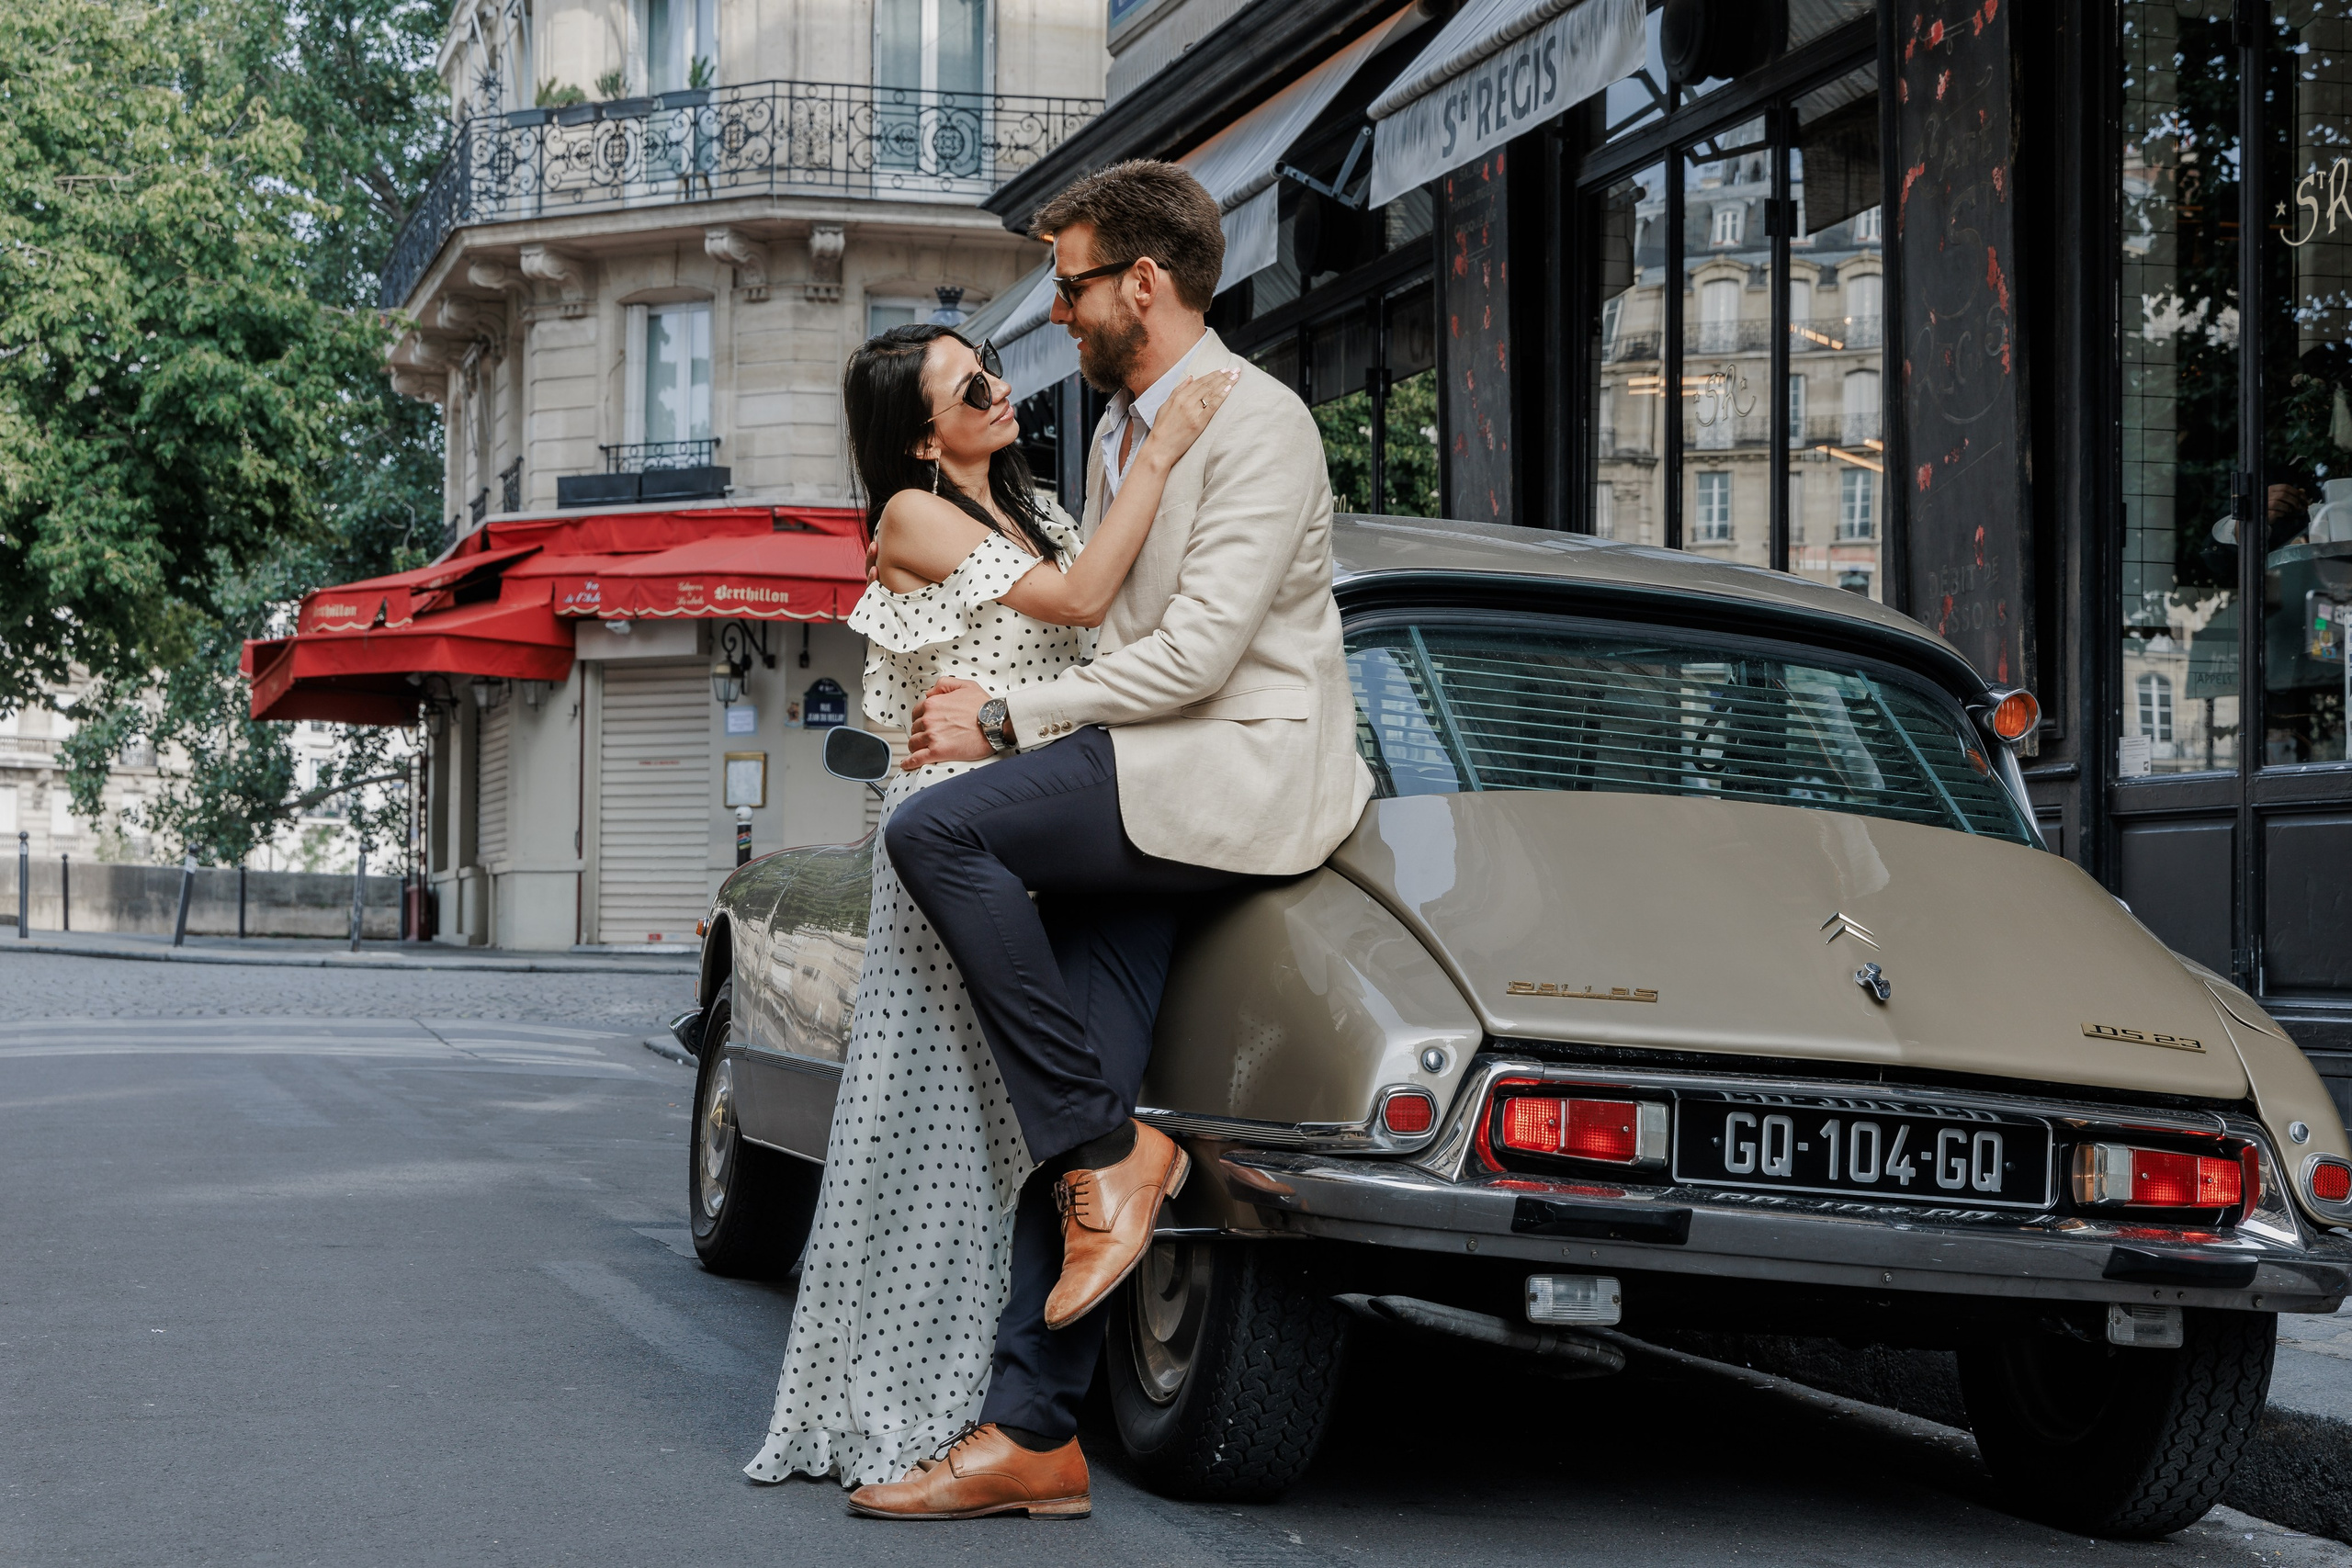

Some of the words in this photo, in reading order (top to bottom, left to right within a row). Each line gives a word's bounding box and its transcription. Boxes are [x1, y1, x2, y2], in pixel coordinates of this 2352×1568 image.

[1476, 35, 1557, 141] REGIS
[1922, 597, 2007, 633] BOSSONS
[2089, 1024, 2144, 1041] DS
[2153, 1033, 2202, 1049] 23
[1724, 1111, 2003, 1193] GQ-104-GQ
